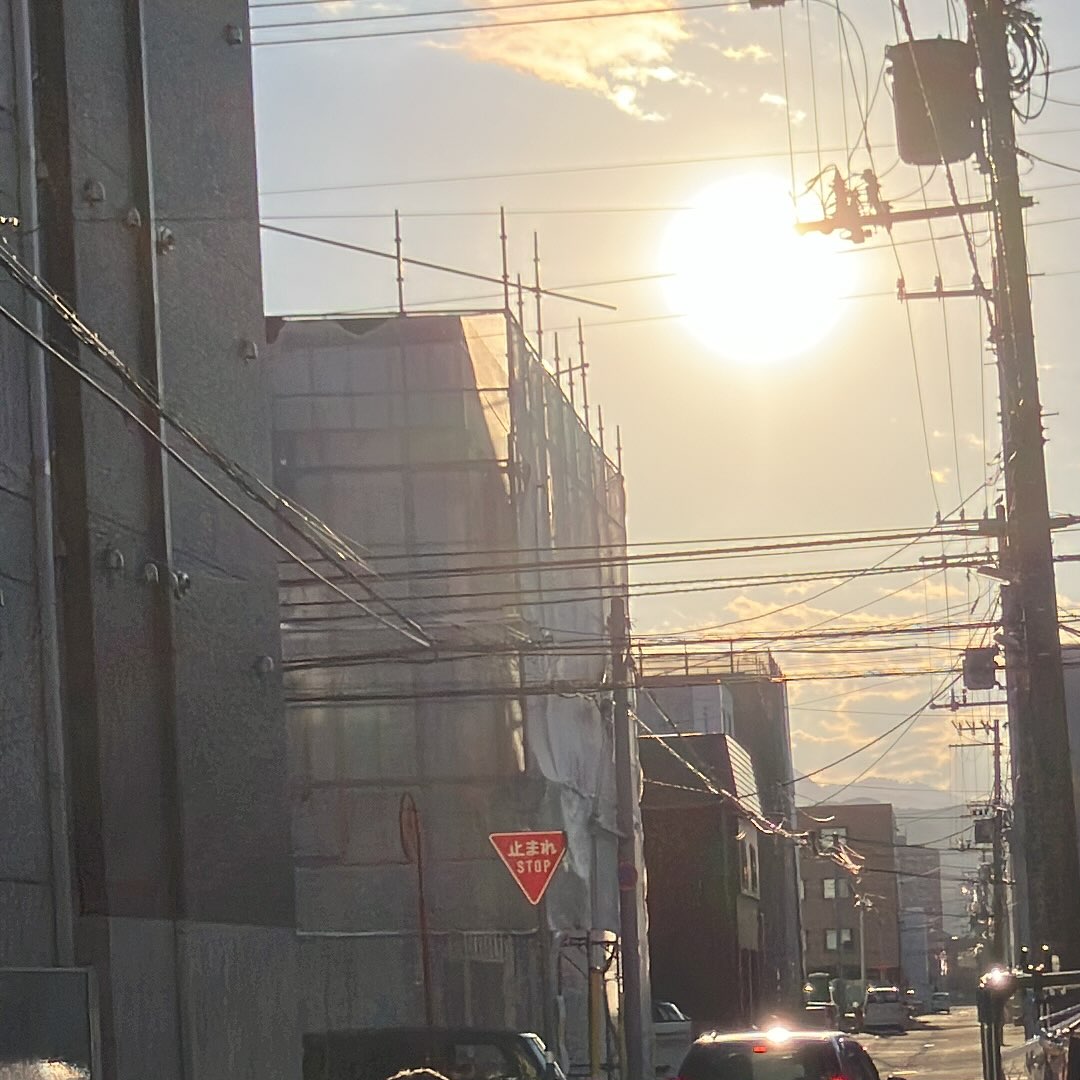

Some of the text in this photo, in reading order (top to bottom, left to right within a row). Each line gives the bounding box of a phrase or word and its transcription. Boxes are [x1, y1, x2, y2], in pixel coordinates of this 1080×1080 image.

[507, 839, 558, 858] 止まれ
[516, 859, 552, 874] STOP
